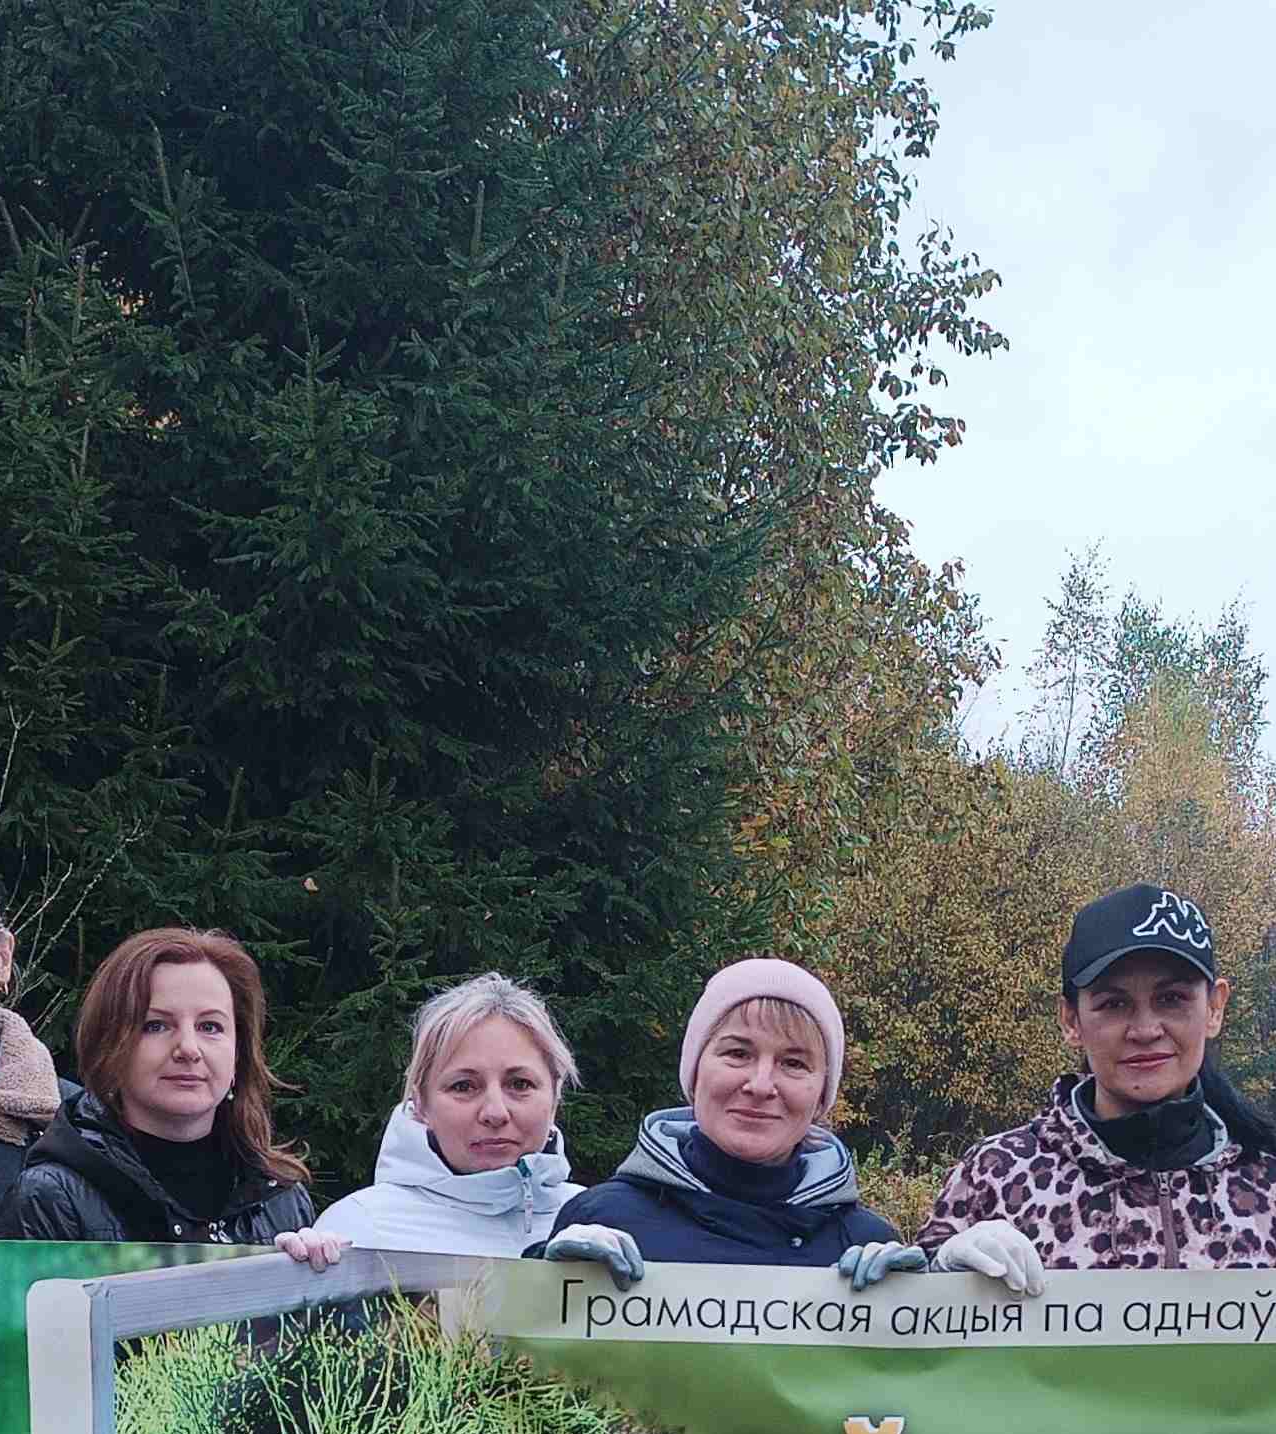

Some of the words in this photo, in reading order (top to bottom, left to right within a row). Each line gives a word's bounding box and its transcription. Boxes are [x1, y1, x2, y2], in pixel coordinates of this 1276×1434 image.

[561, 1279, 871, 1335] Грамадская
[890, 1299, 1023, 1341] акцыя
[1043, 1303, 1103, 1335] па
